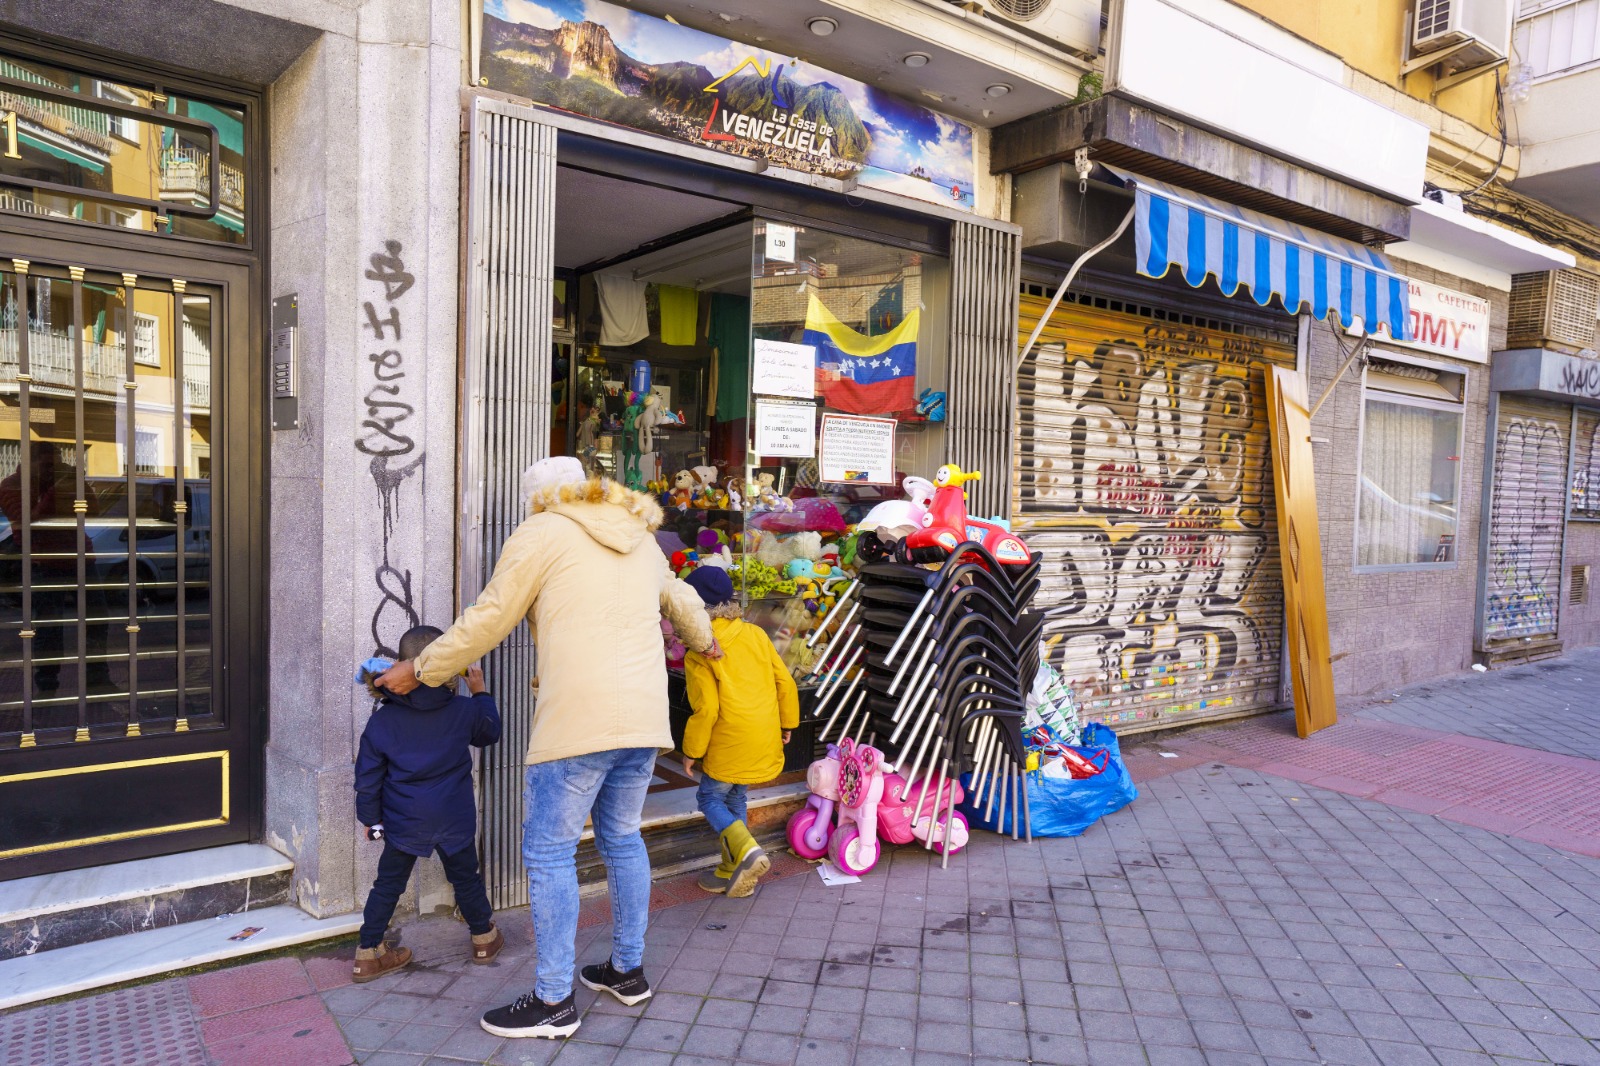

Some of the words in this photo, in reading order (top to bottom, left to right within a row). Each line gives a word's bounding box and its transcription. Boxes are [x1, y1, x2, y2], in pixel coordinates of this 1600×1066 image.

[722, 109, 831, 159] VENEZUELA
[771, 108, 787, 124] La
[791, 113, 817, 132] Casa
[820, 122, 833, 137] de
[1437, 292, 1487, 315] CAFETERIA
